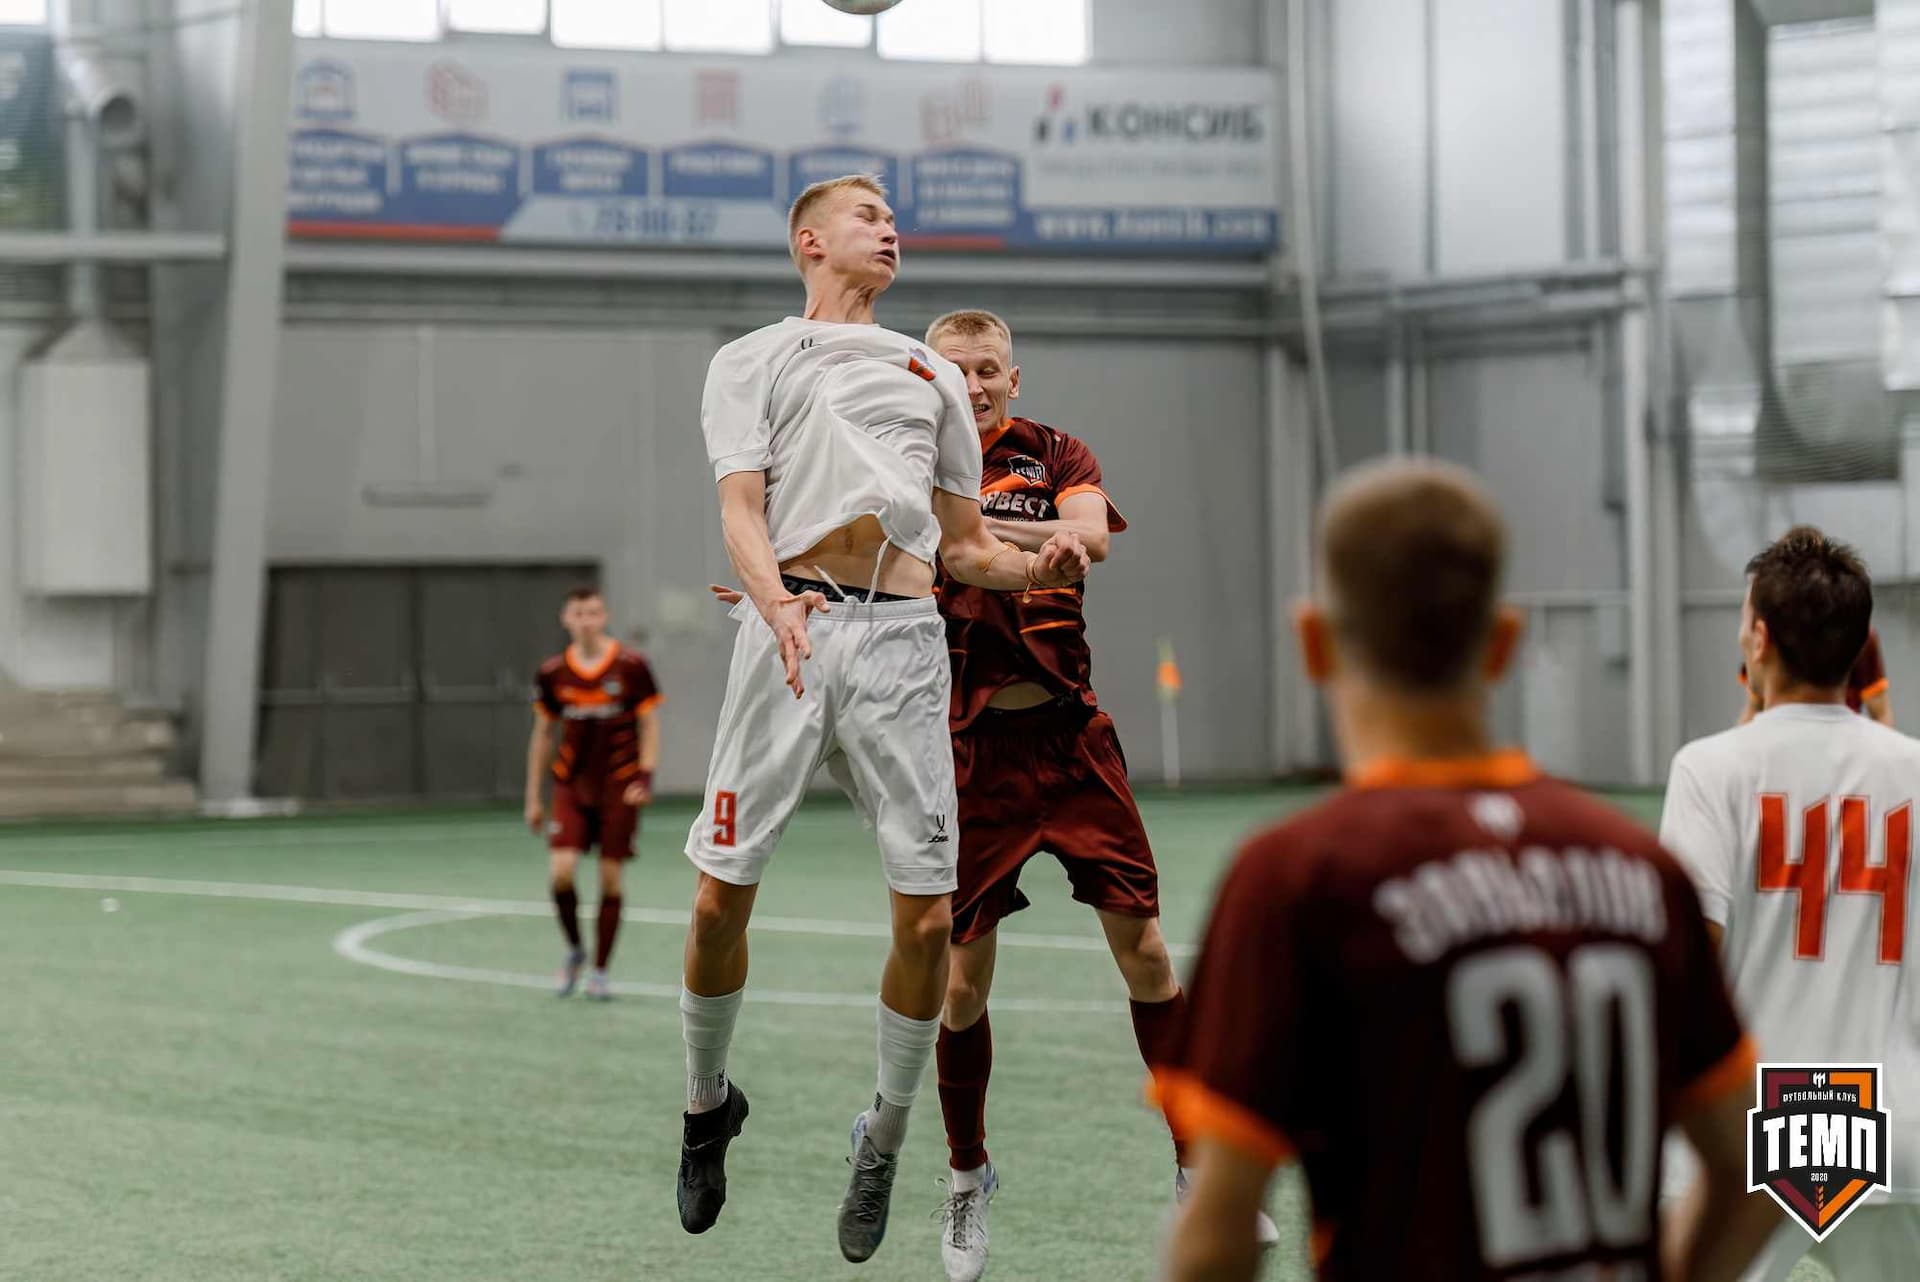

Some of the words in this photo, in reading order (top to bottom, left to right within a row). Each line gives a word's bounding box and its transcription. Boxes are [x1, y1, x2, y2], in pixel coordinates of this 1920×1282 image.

[1088, 103, 1264, 141] КОНСИБ
[713, 790, 736, 846] 9
[1757, 793, 1913, 964] 44
[1448, 945, 1660, 1267] 20
